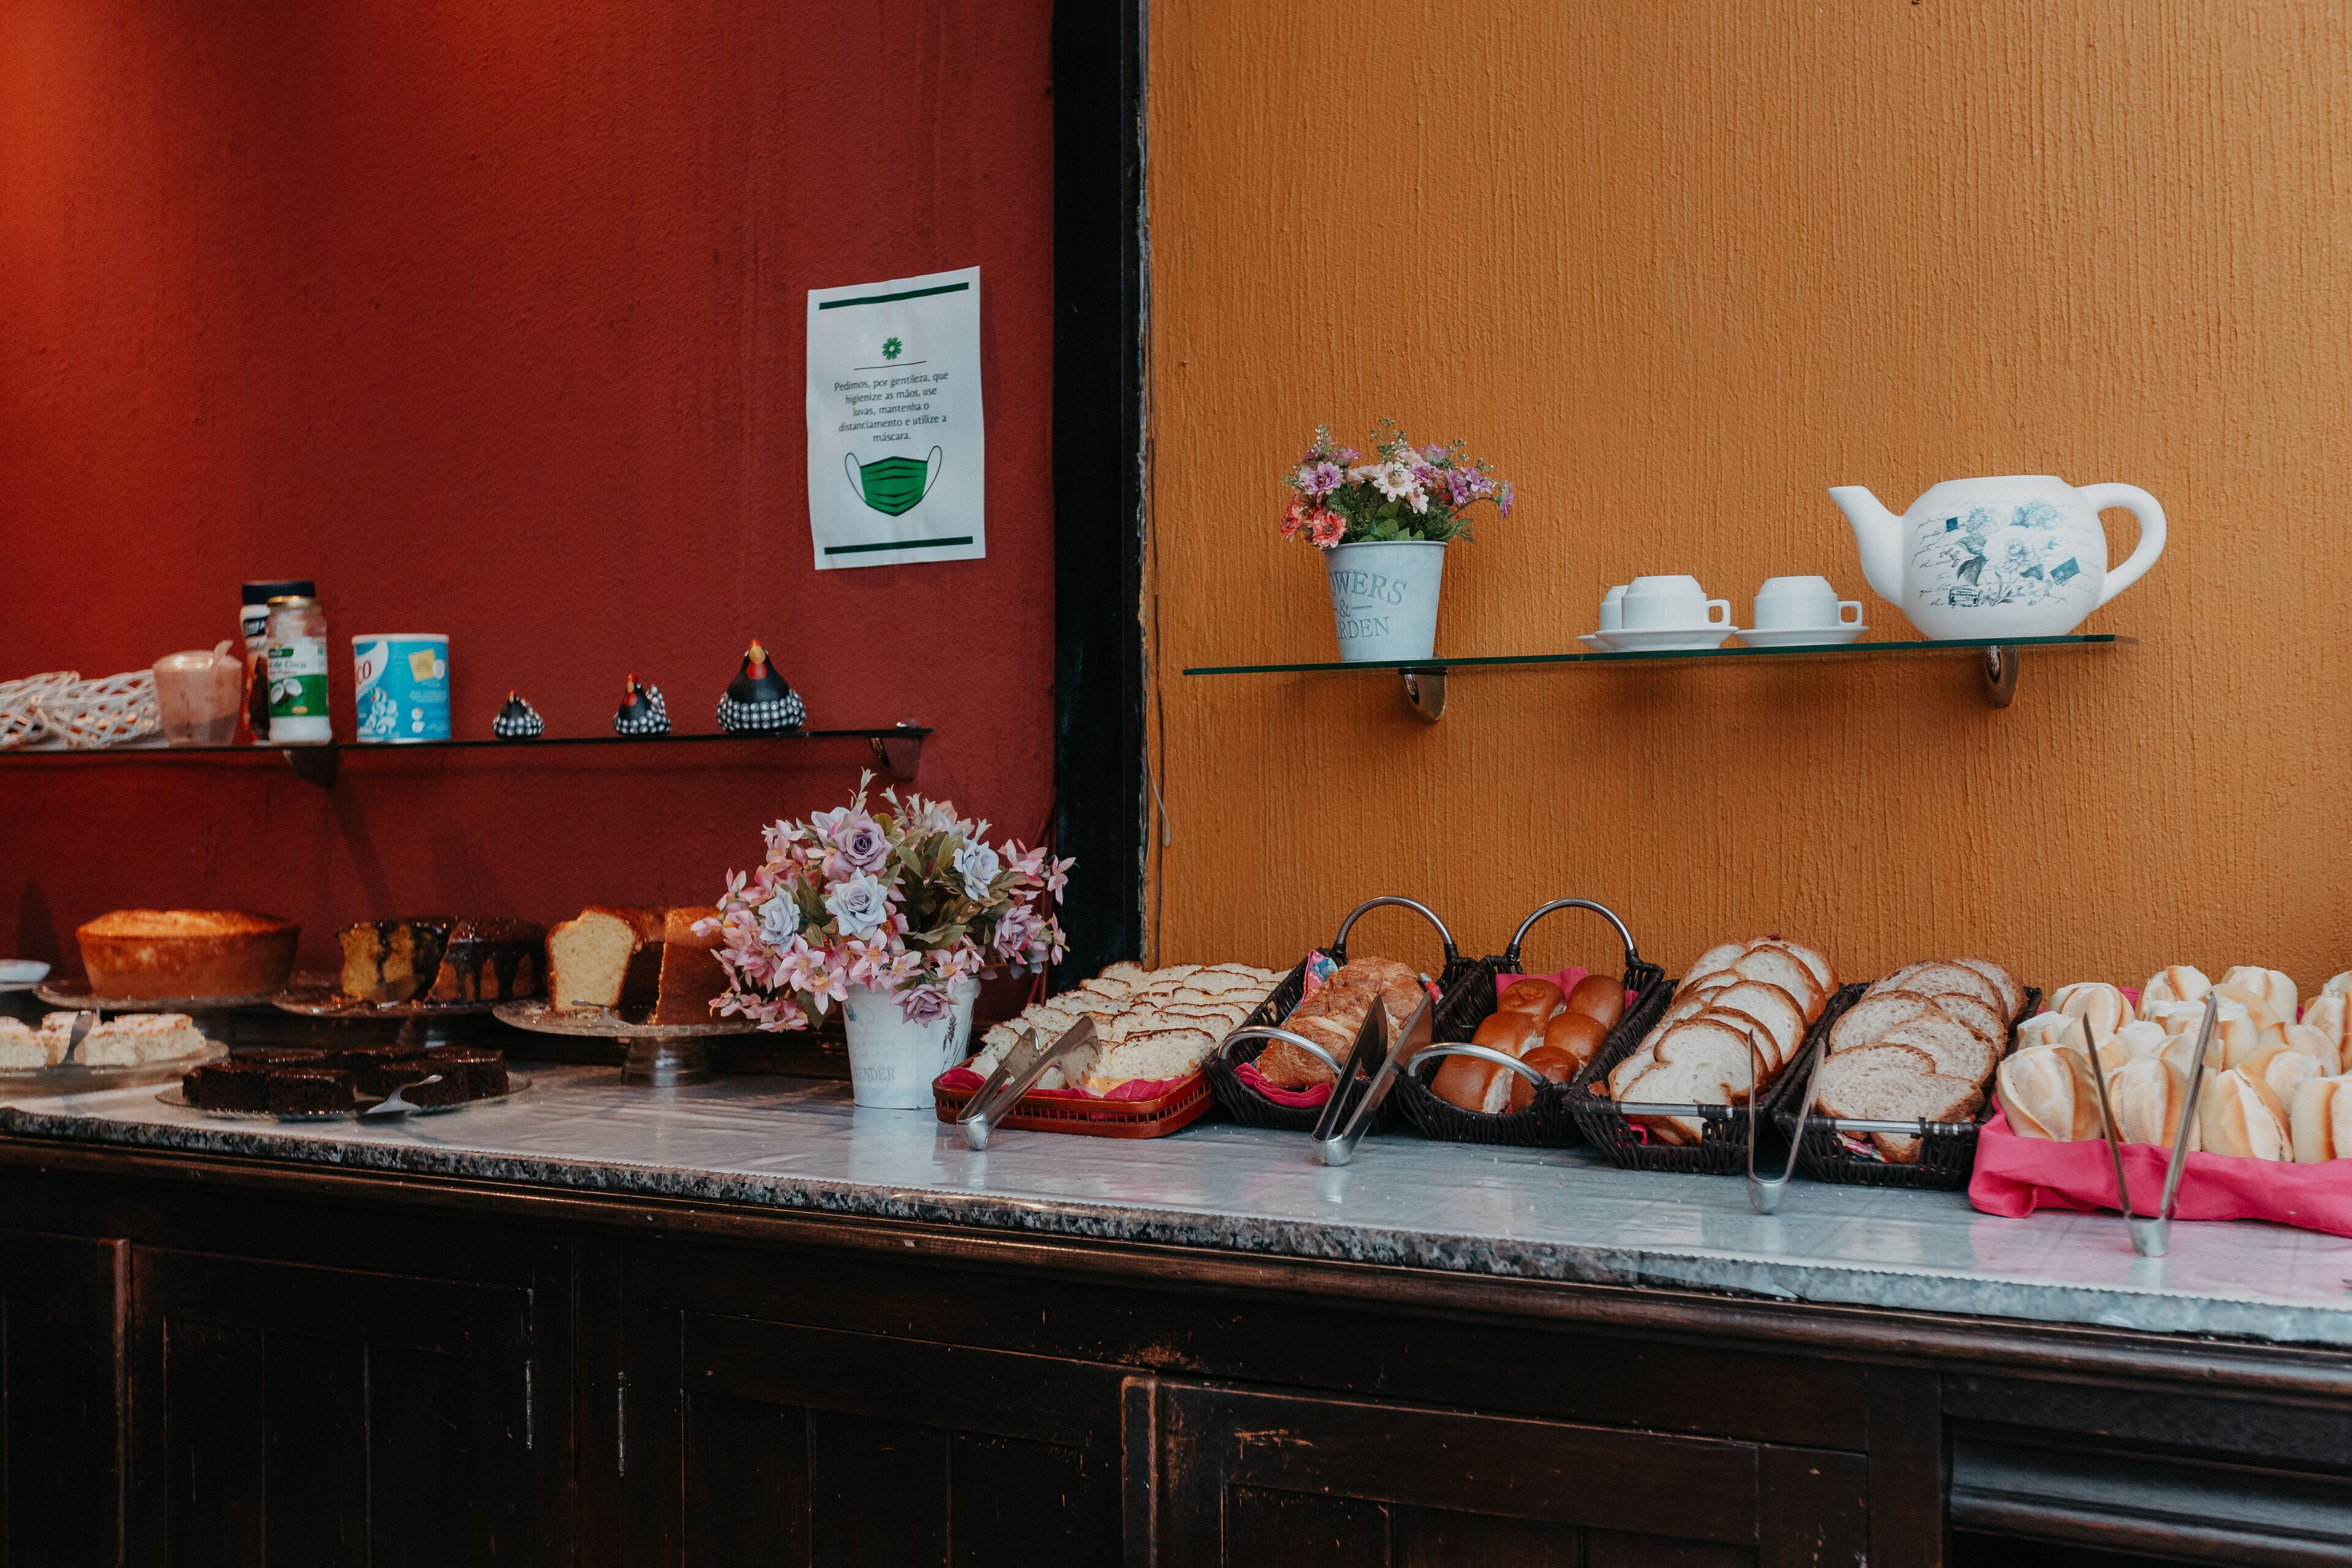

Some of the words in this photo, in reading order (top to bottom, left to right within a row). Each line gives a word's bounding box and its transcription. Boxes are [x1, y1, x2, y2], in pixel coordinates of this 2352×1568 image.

[834, 381, 870, 391] Pedimos,
[873, 379, 888, 390] por
[890, 374, 930, 388] gentileza,
[932, 372, 949, 383] que
[845, 393, 882, 405] higienize
[896, 389, 921, 398] mãos,
[922, 387, 937, 396] use
[853, 407, 876, 417] luvas,
[879, 402, 921, 414] mantenha
[839, 418, 903, 432] distanciamento
[913, 415, 939, 425] utilize
[873, 432, 911, 442] máscara.
